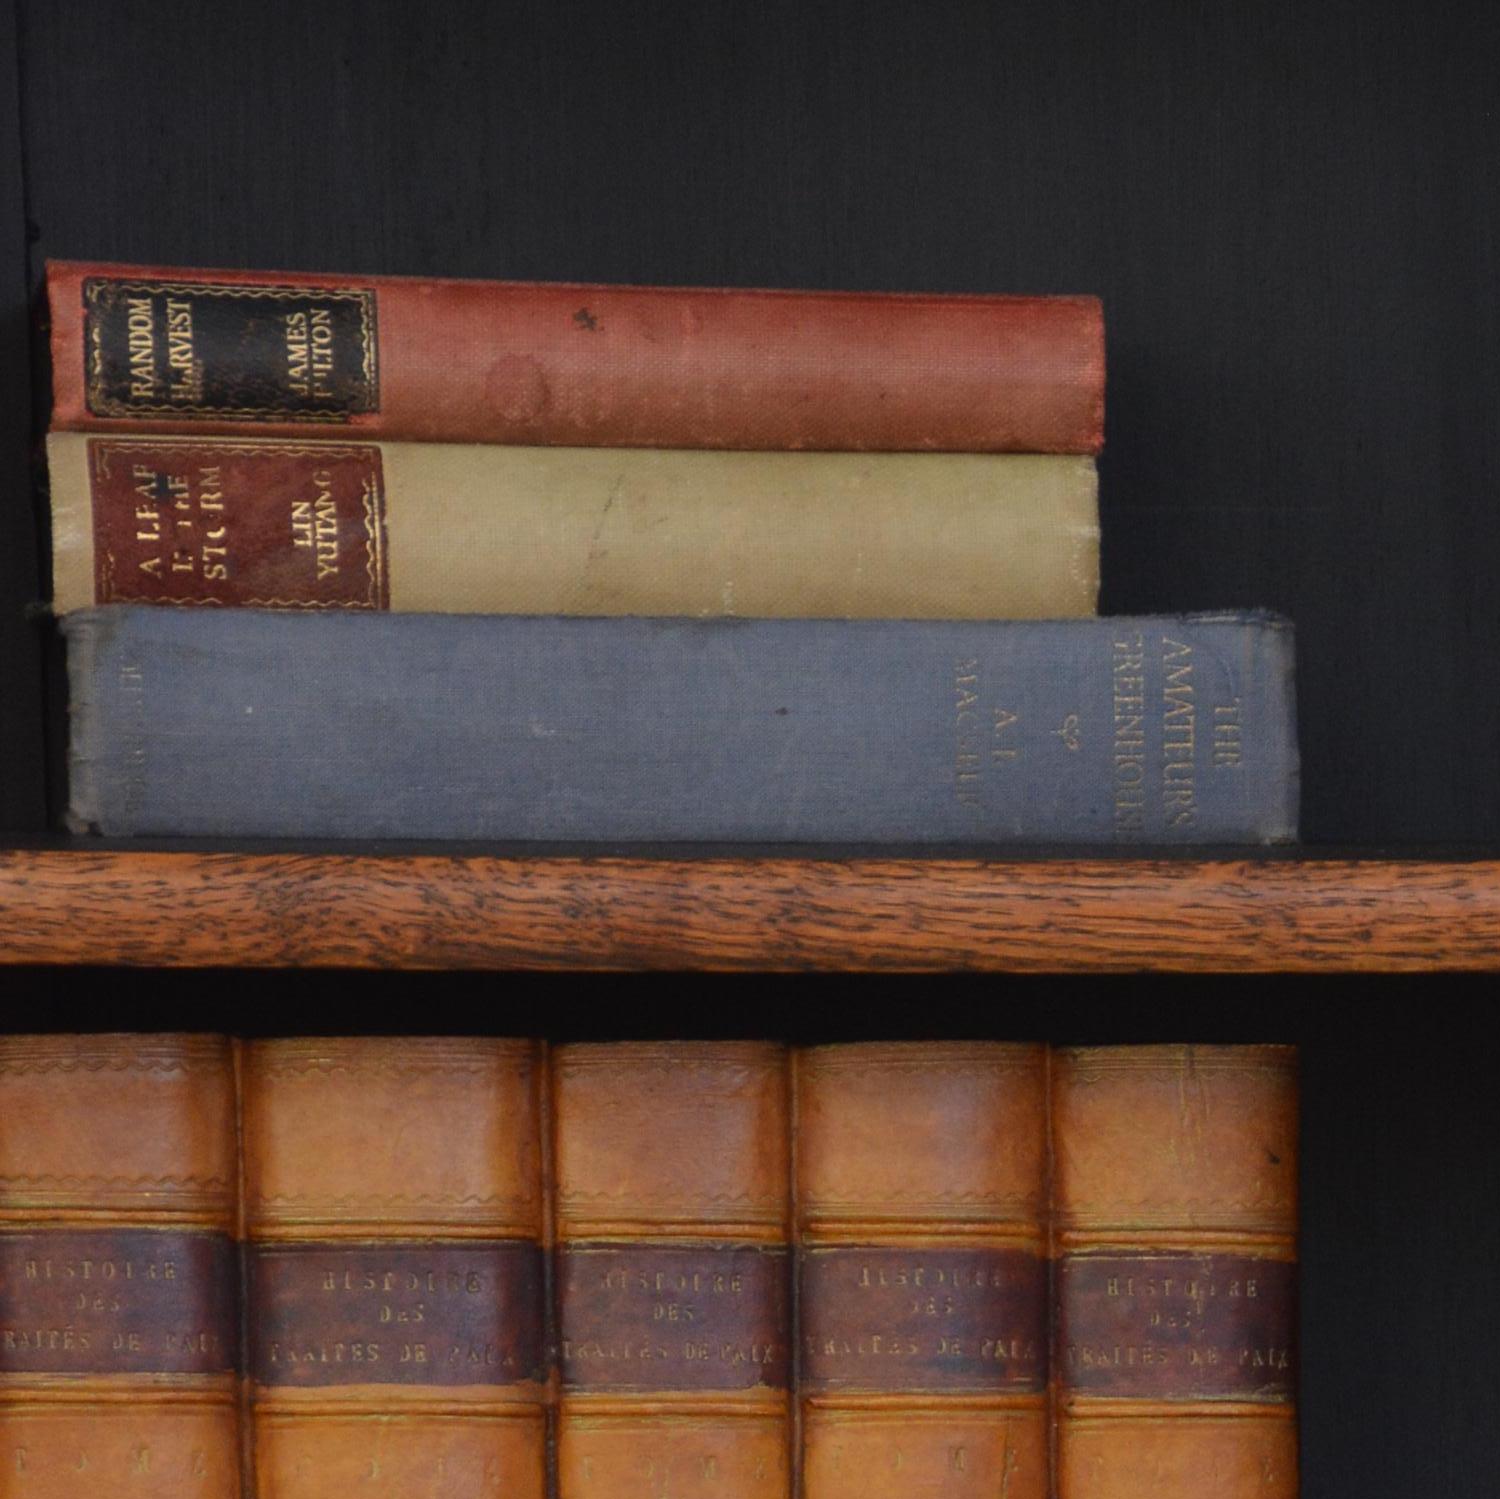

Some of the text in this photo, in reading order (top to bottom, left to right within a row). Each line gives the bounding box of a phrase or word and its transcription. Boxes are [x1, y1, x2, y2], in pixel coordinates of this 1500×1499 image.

[128, 297, 155, 398] RANDOM
[286, 311, 310, 395] JAMES
[292, 501, 313, 548] LIN
[139, 557, 163, 579] A
